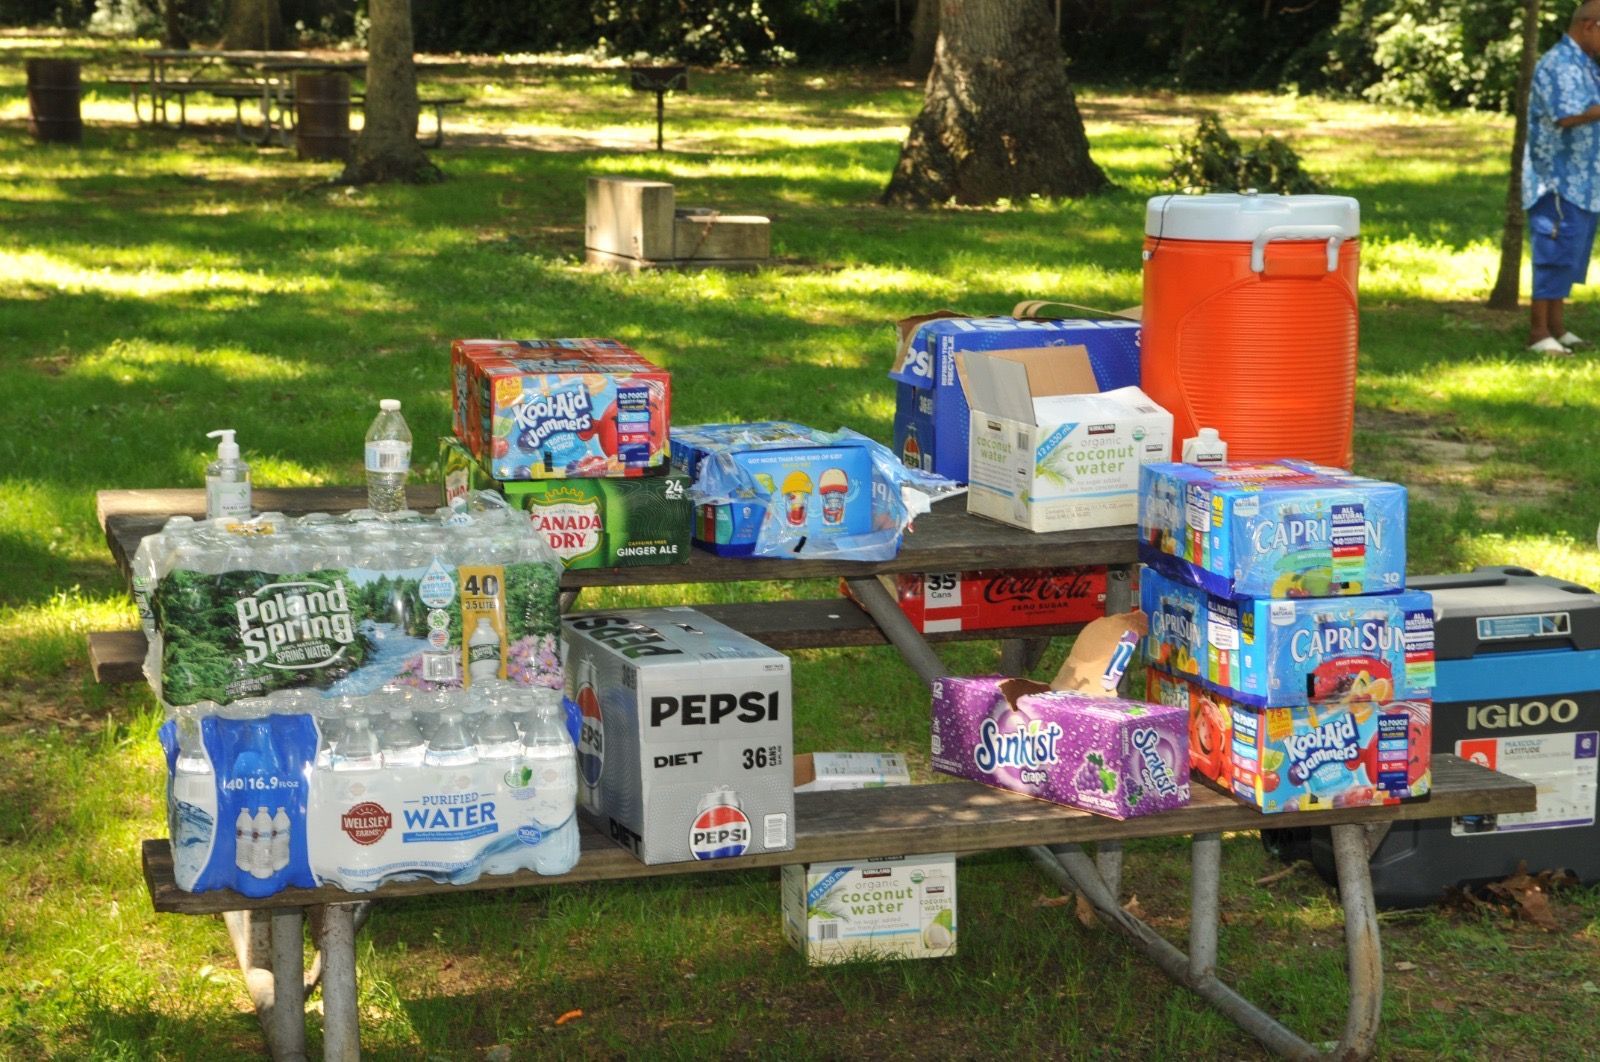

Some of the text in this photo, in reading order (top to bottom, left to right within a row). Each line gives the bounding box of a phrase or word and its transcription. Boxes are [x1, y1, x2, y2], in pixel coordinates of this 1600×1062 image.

[512, 383, 590, 430] Kool-Aid
[527, 413, 593, 448] Jammers
[1081, 437, 1121, 450] organic
[1067, 444, 1134, 463] coconut
[1075, 461, 1125, 475] water
[664, 480, 684, 494] 24
[530, 514, 604, 532] CANADA
[549, 532, 587, 549] DRY
[616, 544, 678, 557] GINGER ALE
[464, 574, 499, 596] 40
[927, 574, 957, 591] 35
[1383, 572, 1399, 584] 10
[931, 591, 952, 599] Cans
[235, 580, 350, 634] Poland
[1011, 601, 1069, 612] ZERO SUGAR
[242, 613, 355, 664] Spring
[276, 644, 333, 664] SPRING WATER
[651, 691, 779, 727] PEPSI
[1467, 699, 1579, 731] IGLOO
[1284, 711, 1356, 762] Kool-Aid
[976, 720, 1061, 773] Sunkist
[1504, 747, 1540, 755] LATITUDE
[654, 751, 703, 769] DIET
[742, 746, 767, 770] 36
[769, 745, 777, 767] CANS
[1132, 727, 1177, 797] Sunkist
[1296, 742, 1359, 780] Jammers
[248, 776, 278, 790] 16.9
[1021, 769, 1047, 785] Grape
[422, 792, 479, 806] PURIFIED
[344, 815, 389, 829] WELLSLEY
[403, 801, 496, 830] WATER
[609, 816, 642, 855] DIET
[694, 829, 748, 845] PEPSI
[855, 879, 899, 891] organic
[841, 887, 913, 903] coconut
[851, 901, 904, 915] water
